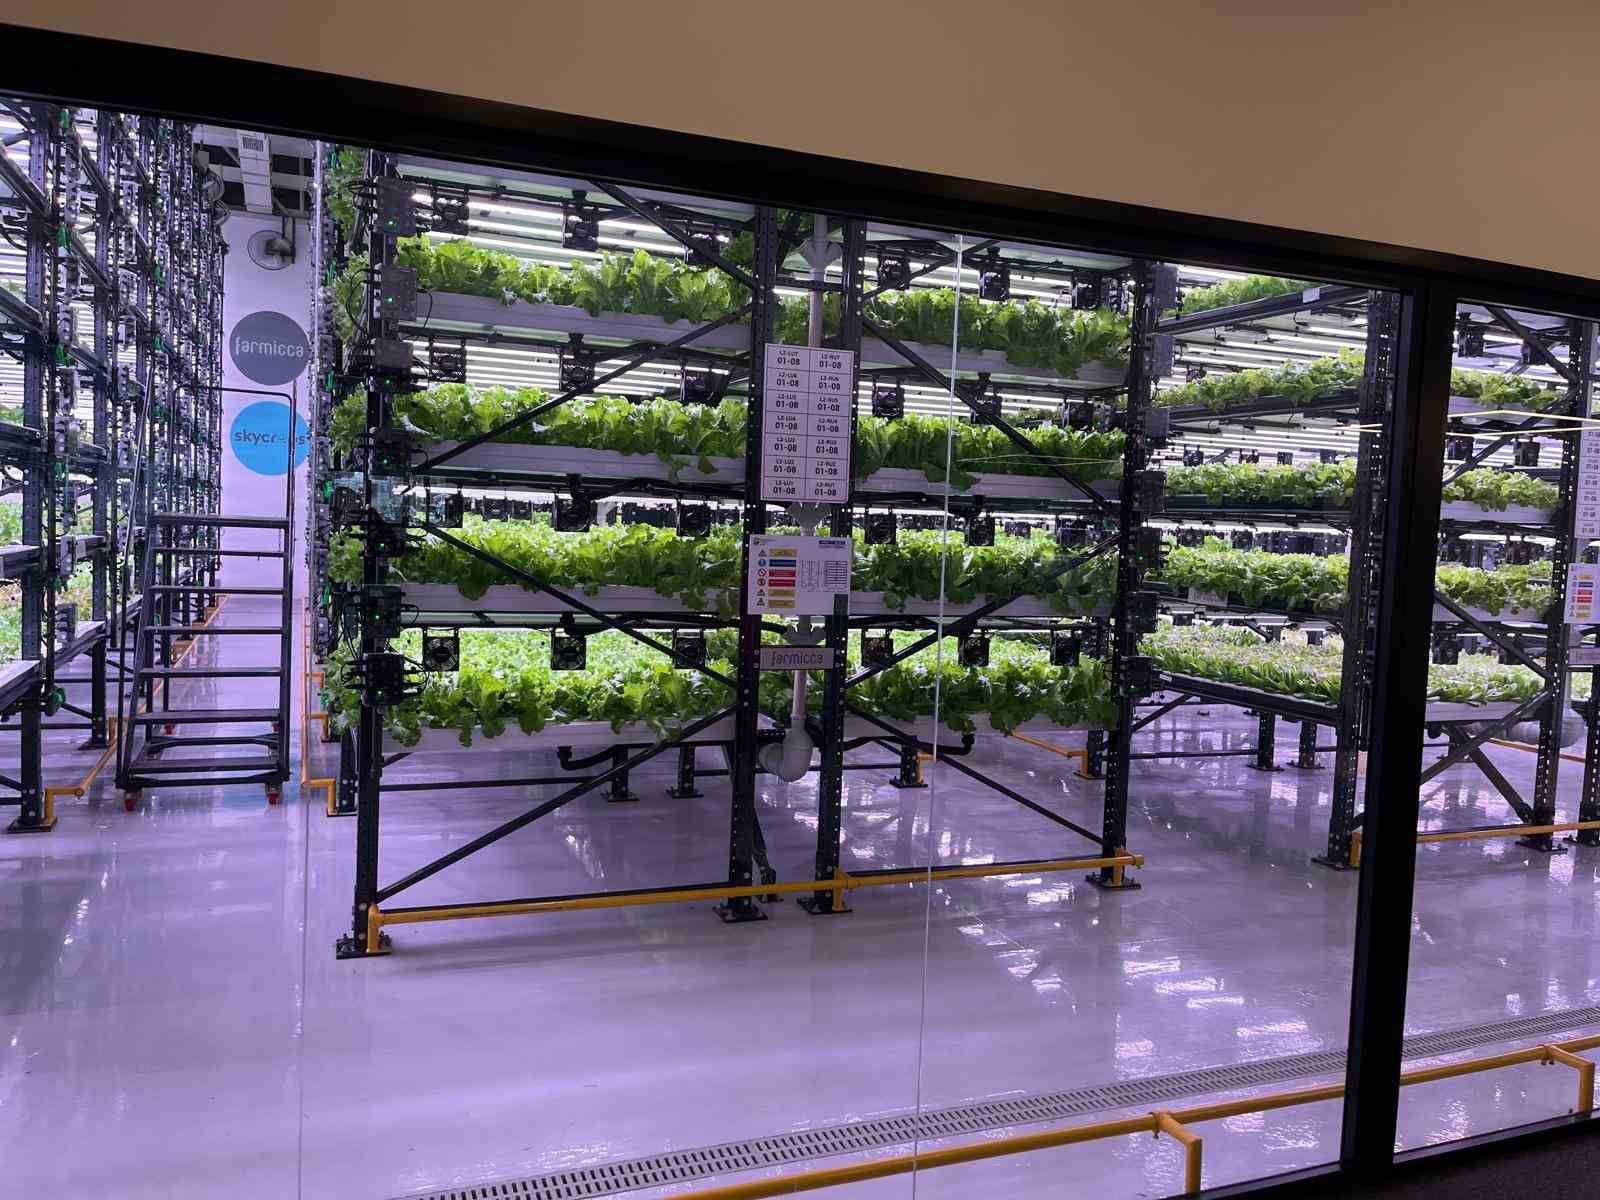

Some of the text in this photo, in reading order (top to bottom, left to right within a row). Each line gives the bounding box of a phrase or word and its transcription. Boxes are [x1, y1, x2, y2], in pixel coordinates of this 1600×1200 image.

[235, 336, 304, 358] farmicca
[777, 357, 800, 366] 01-08
[820, 360, 842, 369] 01-08
[776, 378, 799, 387] 01-08
[819, 382, 841, 391] 01-08
[776, 400, 799, 409] 01-08
[817, 404, 840, 412] 01-08
[775, 422, 798, 430] 01-08
[816, 425, 839, 433] 01-08
[234, 427, 305, 446] skycrs
[774, 443, 797, 452] 01-08
[816, 446, 838, 454] 01-08
[773, 465, 797, 474] 01-08
[772, 486, 796, 495] 01-08
[814, 488, 837, 496] 01-08
